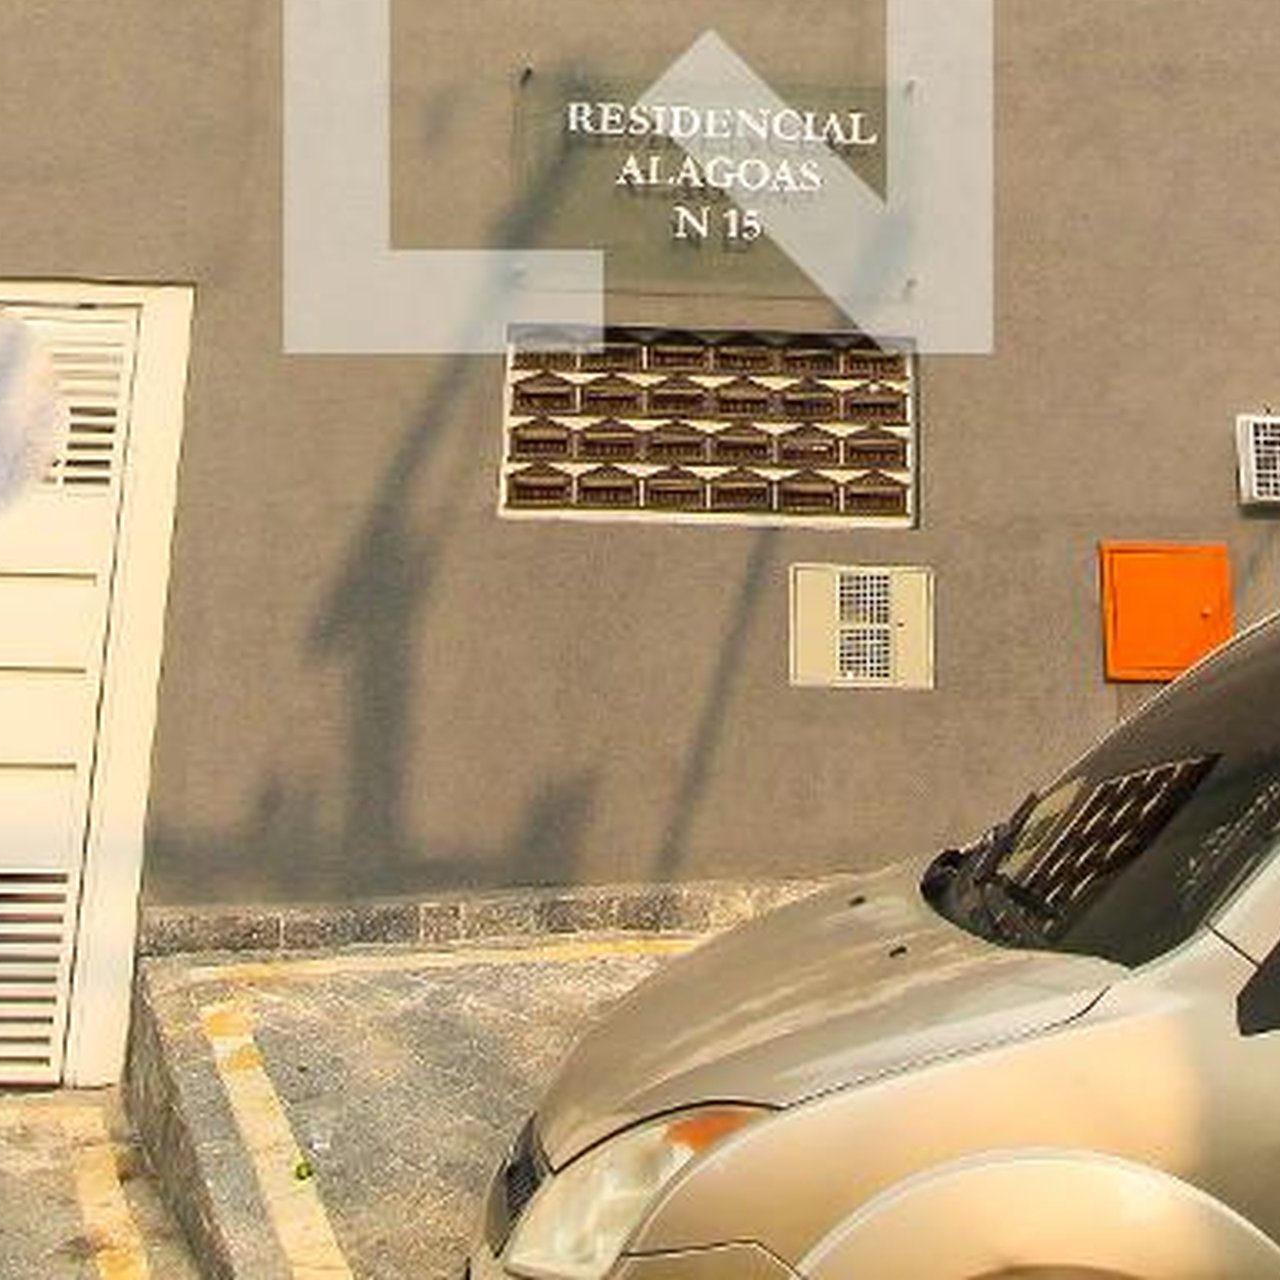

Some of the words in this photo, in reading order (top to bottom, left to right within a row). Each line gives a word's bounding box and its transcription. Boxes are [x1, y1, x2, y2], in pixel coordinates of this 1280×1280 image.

[565, 101, 878, 145] RESIDENCIAL
[616, 154, 824, 193] ALAGOAS
[673, 205, 710, 239] N
[723, 209, 763, 241] 15
